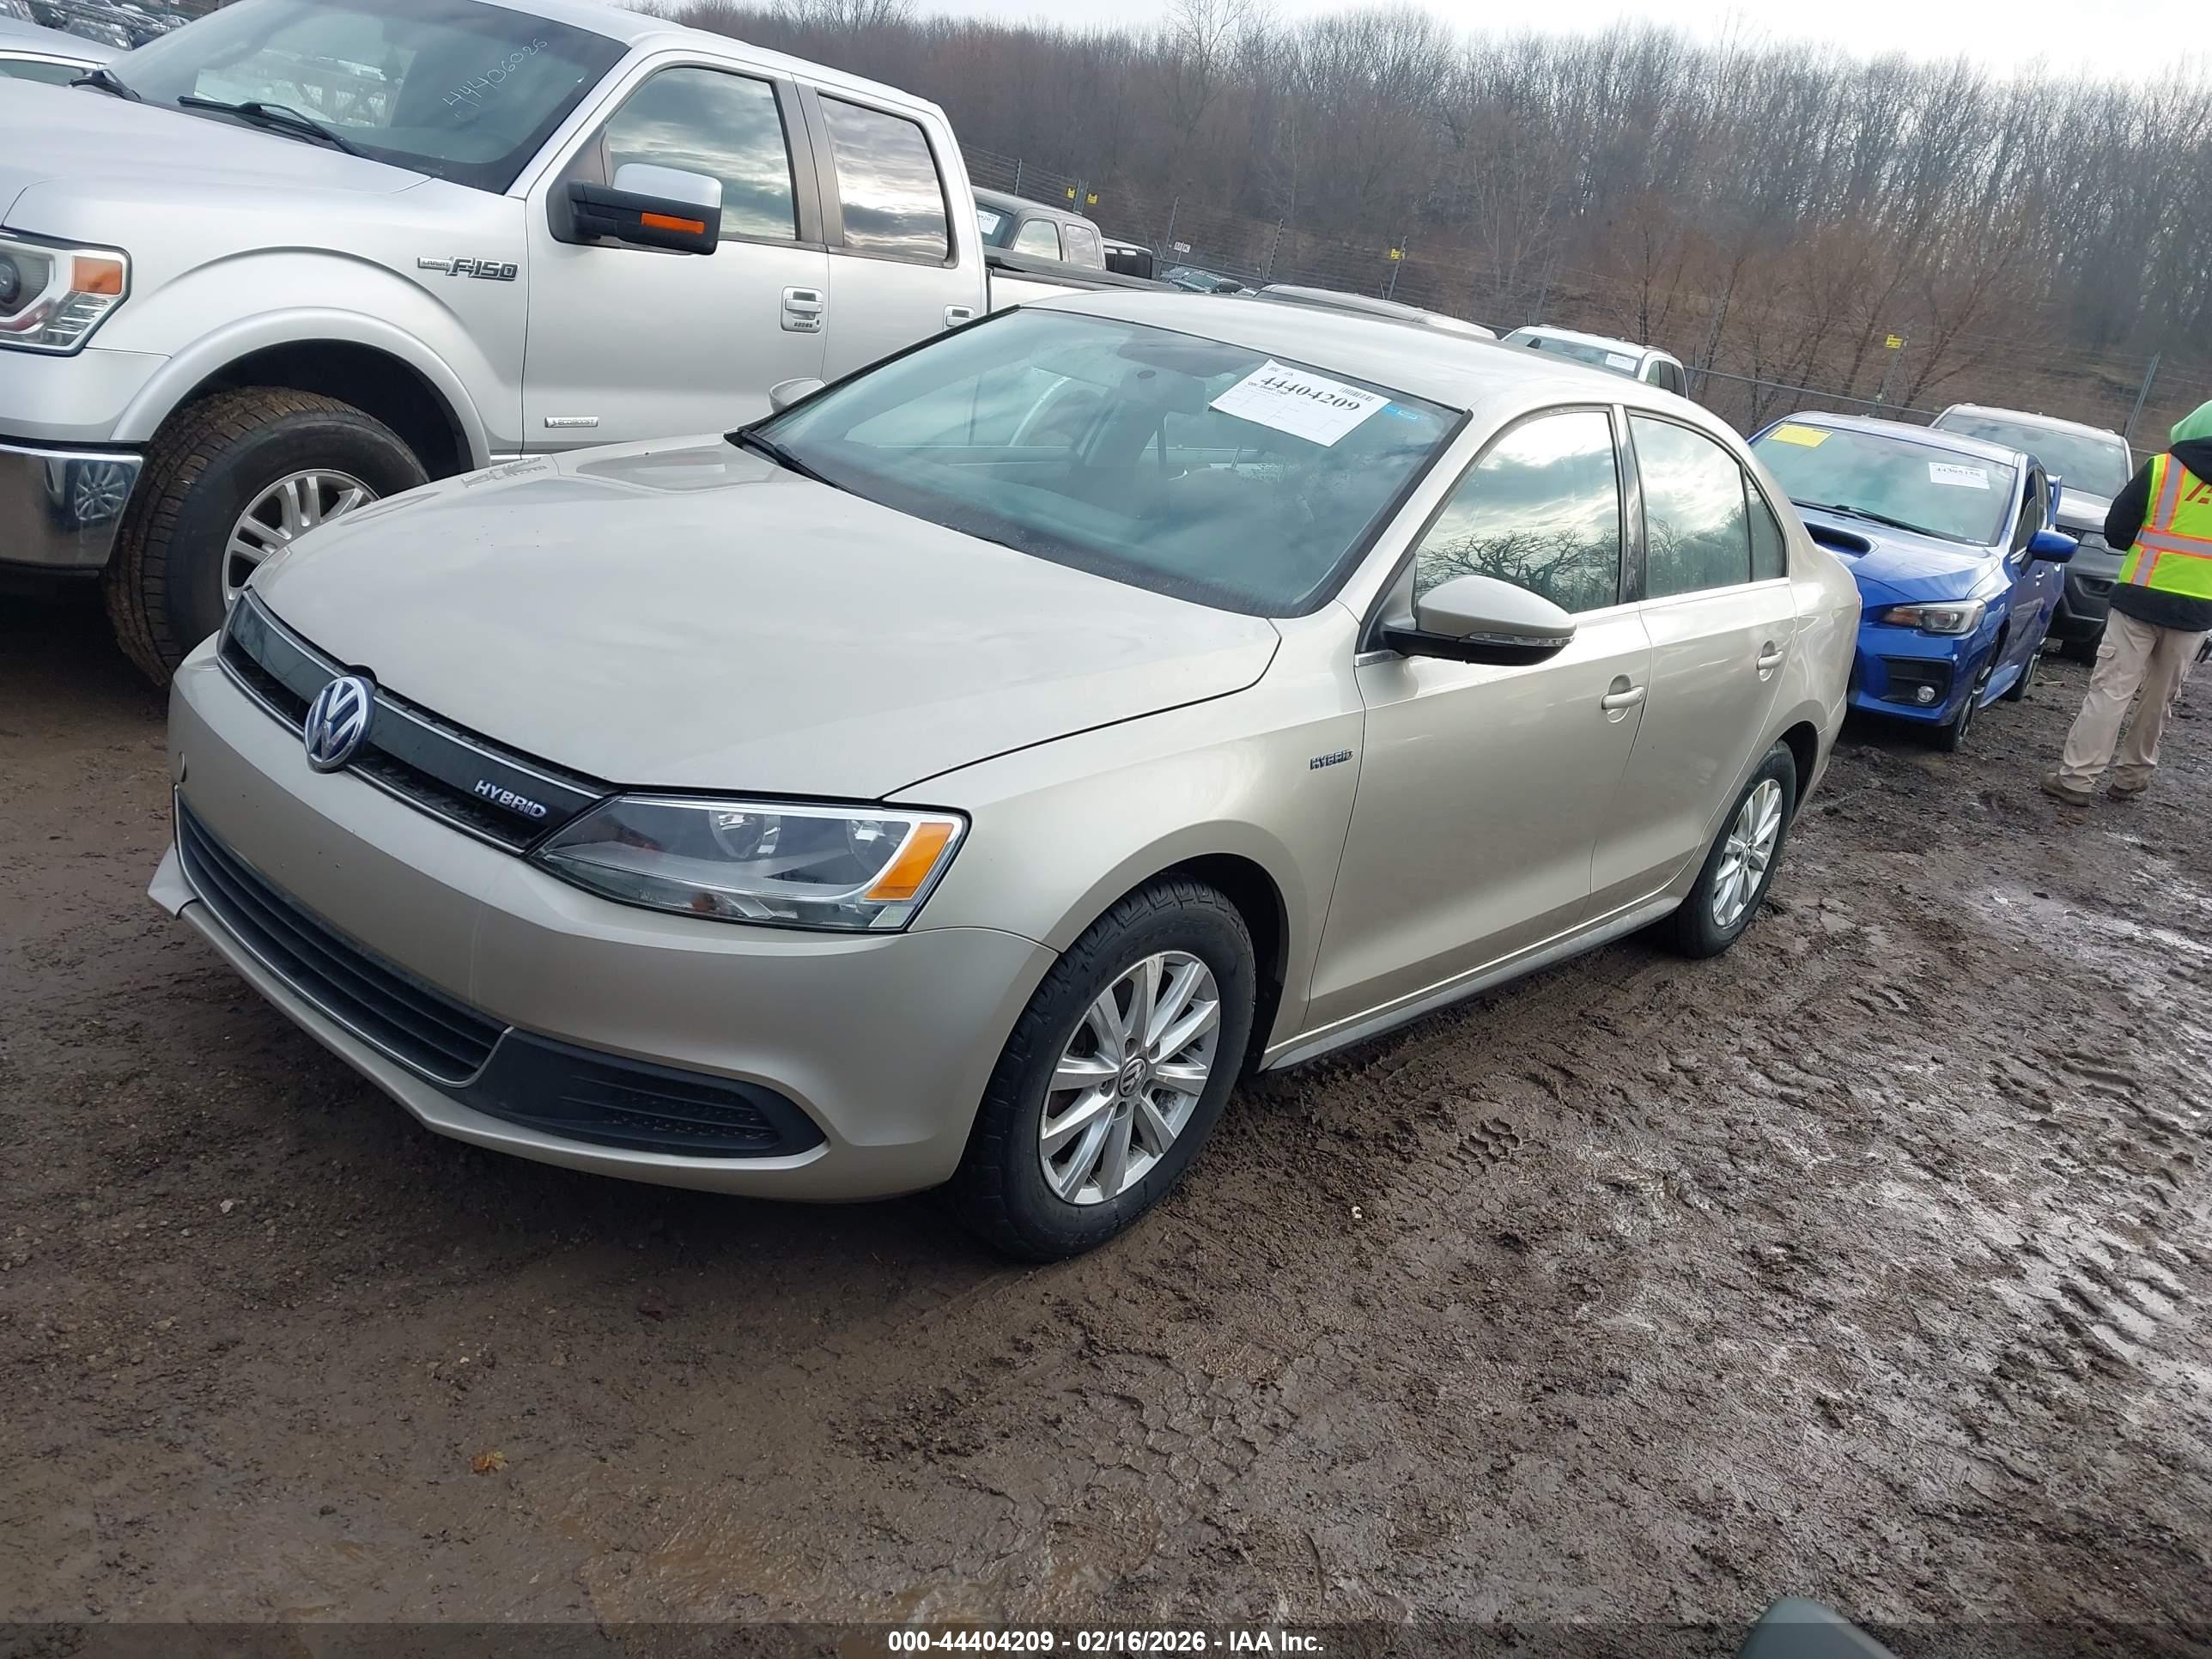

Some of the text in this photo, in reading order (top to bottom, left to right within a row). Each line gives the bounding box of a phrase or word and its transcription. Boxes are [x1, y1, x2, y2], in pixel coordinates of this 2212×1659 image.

[1261, 376, 1361, 410] 44404209
[1310, 750, 1354, 770] HYBRID
[474, 779, 547, 818] HYBRID
